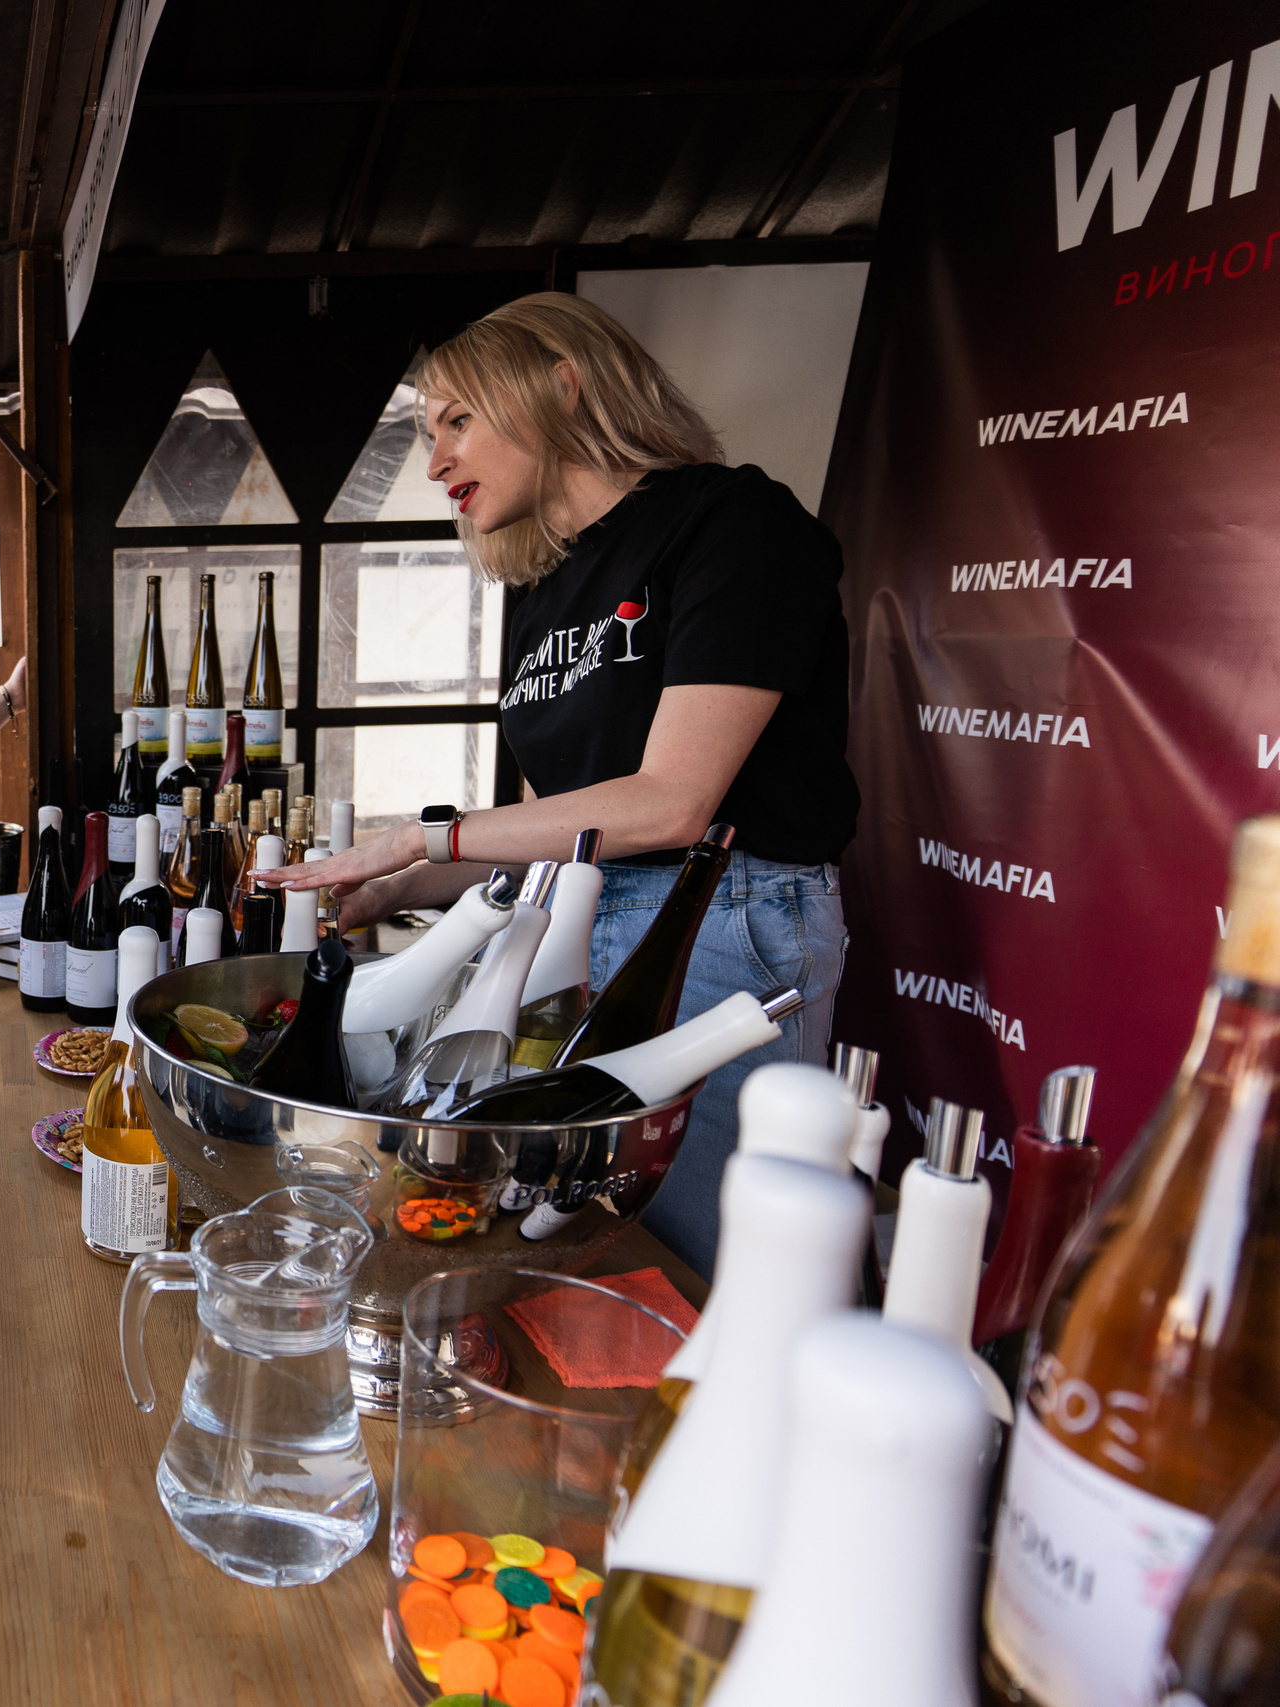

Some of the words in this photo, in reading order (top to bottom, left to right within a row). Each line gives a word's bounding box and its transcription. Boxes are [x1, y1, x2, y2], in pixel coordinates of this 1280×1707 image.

[978, 392, 1189, 447] WINEMAFIA
[951, 557, 1133, 593] WINEMAFIA
[918, 703, 1091, 749] WINEMAFIA
[108, 803, 130, 814] 1950
[158, 792, 183, 804] 3900
[919, 837, 1057, 904] WINEMAFIA
[893, 968, 1027, 1052] WINEMAFIA
[513, 1183, 563, 1206] POL
[567, 1169, 640, 1204] ROGER
